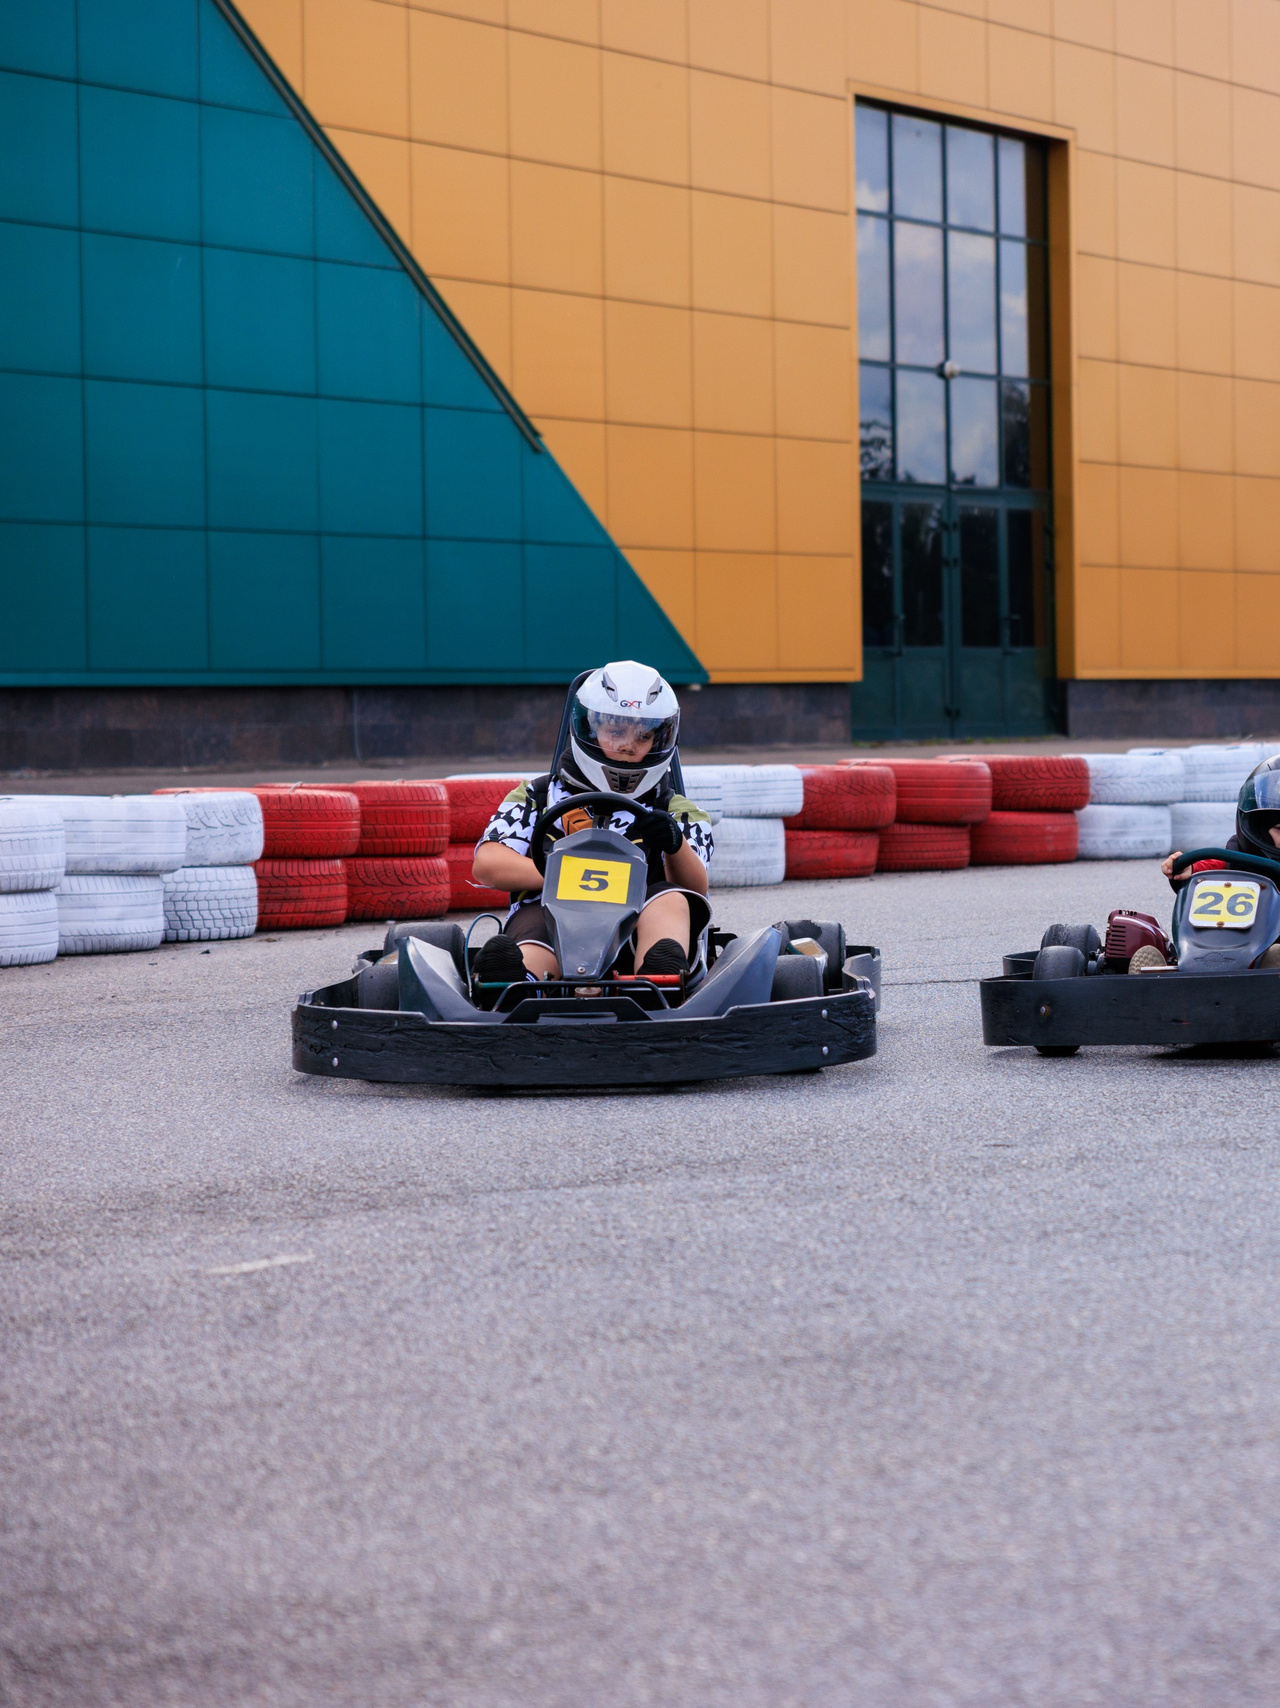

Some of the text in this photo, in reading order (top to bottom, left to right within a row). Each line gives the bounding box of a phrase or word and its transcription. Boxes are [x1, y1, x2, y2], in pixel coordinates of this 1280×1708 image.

[620, 700, 642, 709] GXT
[578, 869, 609, 891] 5
[1193, 891, 1255, 916] 26
